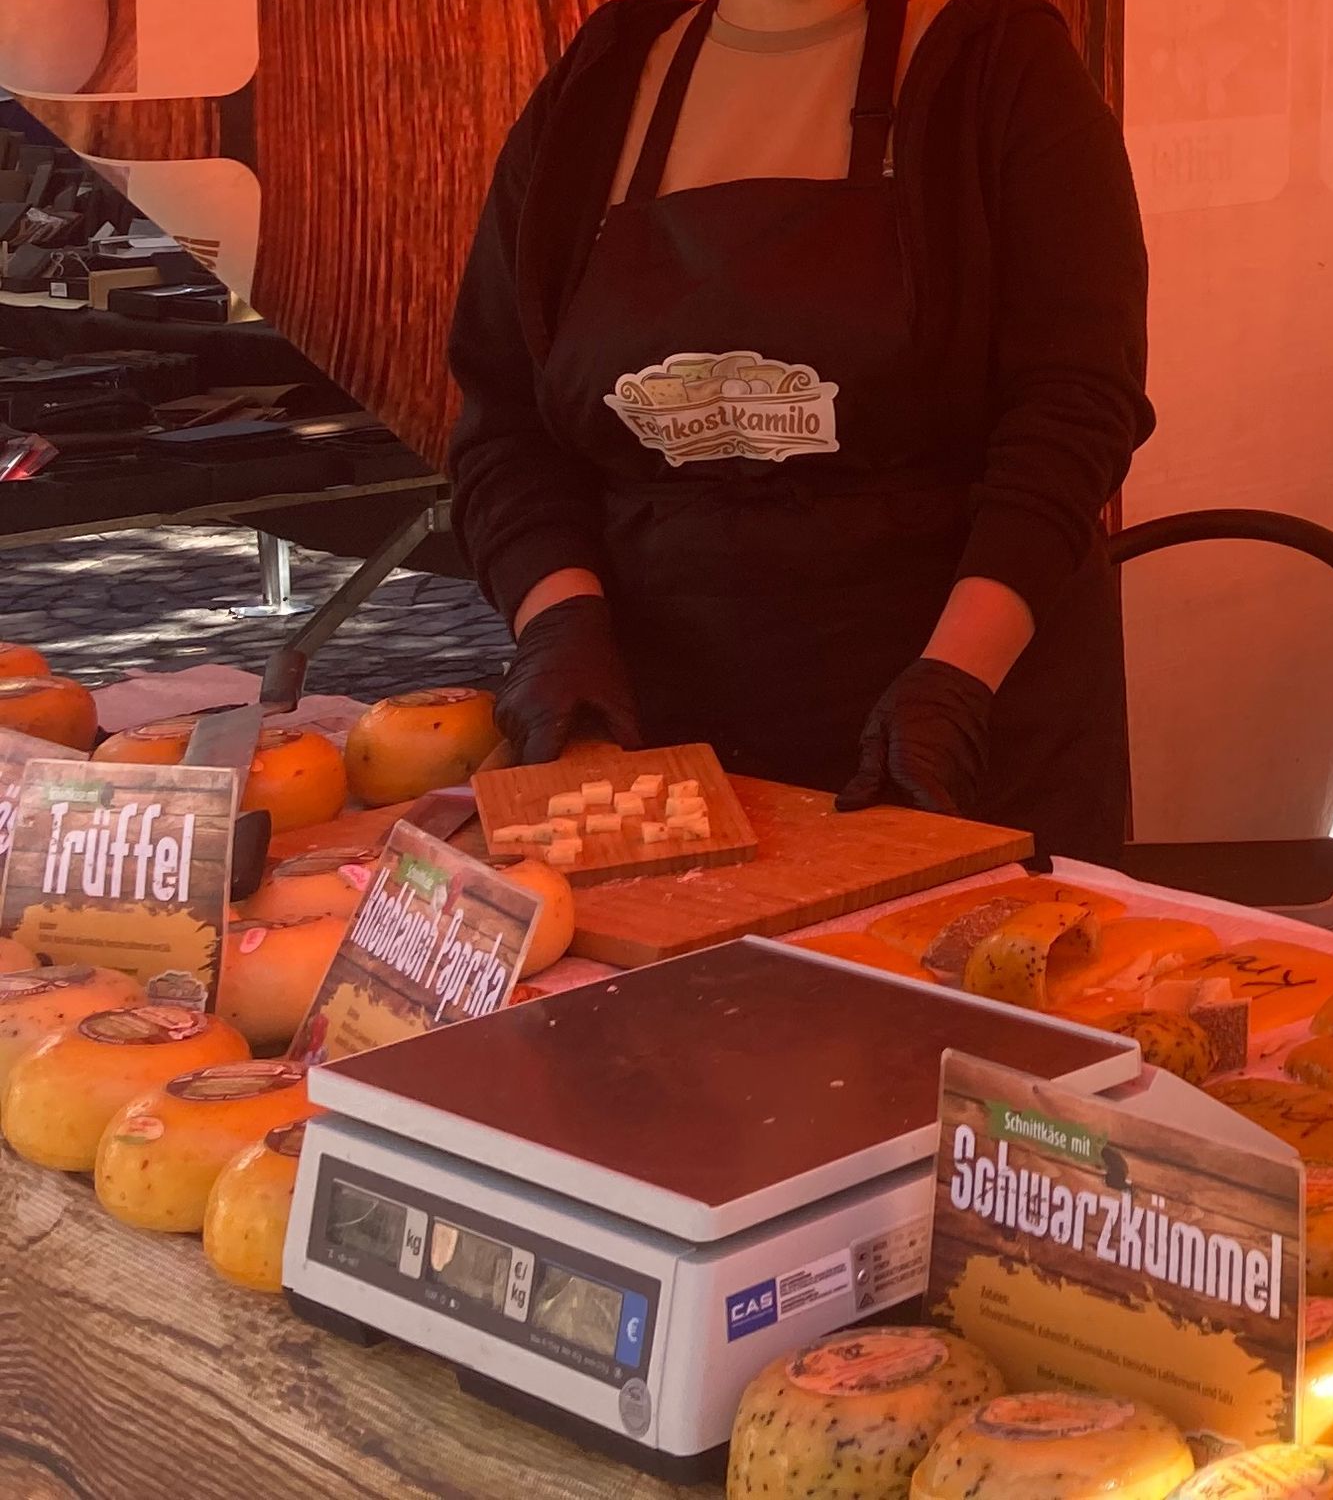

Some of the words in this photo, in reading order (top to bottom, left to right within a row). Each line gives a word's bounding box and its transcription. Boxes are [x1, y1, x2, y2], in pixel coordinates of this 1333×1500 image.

[730, 405, 821, 435] Kamilo
[42, 801, 196, 902] Trüffel
[350, 866, 442, 983] Knoblauch
[424, 908, 506, 1023] Paprika
[1004, 1111, 1067, 1150] Schnittkäse
[1071, 1135, 1091, 1157] mit
[950, 1124, 1283, 1320] Schwarzkümmel
[406, 1232, 423, 1255] kg
[510, 1283, 527, 1308] kg
[730, 1289, 773, 1322] CAS
